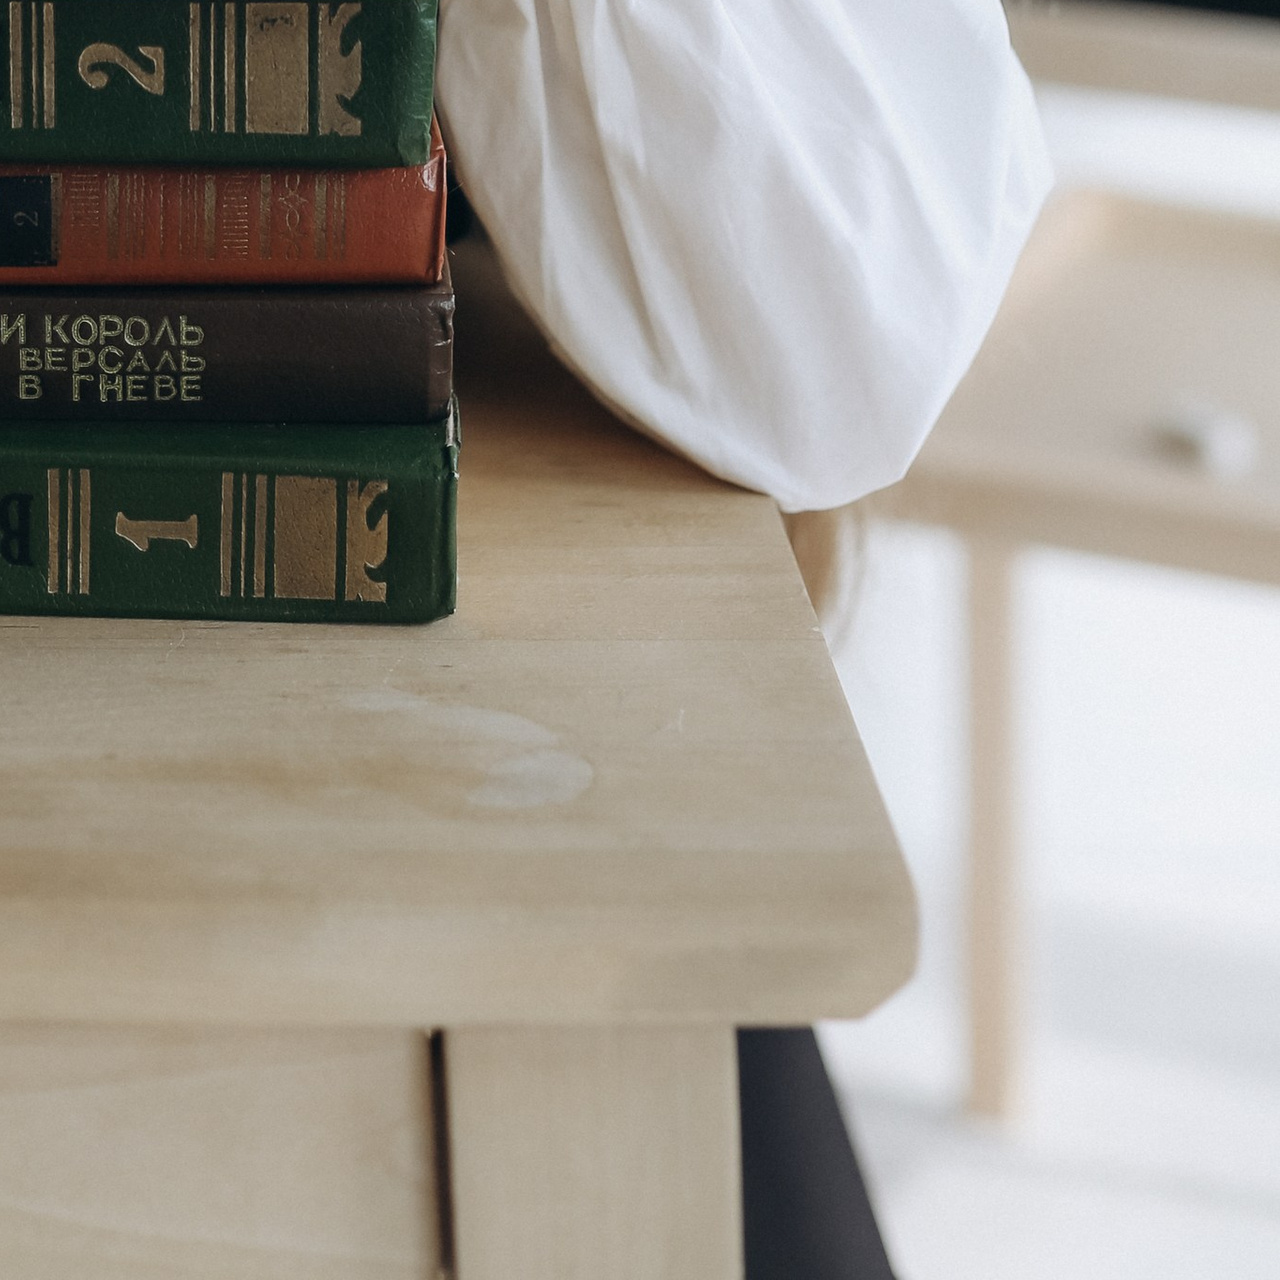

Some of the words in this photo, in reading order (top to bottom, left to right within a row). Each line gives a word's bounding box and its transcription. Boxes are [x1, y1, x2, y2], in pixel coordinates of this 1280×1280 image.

[77, 42, 165, 96] 2
[13, 209, 40, 228] 2
[0, 313, 26, 345] И
[44, 314, 205, 346] КОРОЛЬ
[19, 345, 206, 374] ВЕРСАЛЬ
[19, 374, 43, 400] В
[72, 372, 203, 402] ГНЕВЕ
[115, 511, 199, 553] 1
